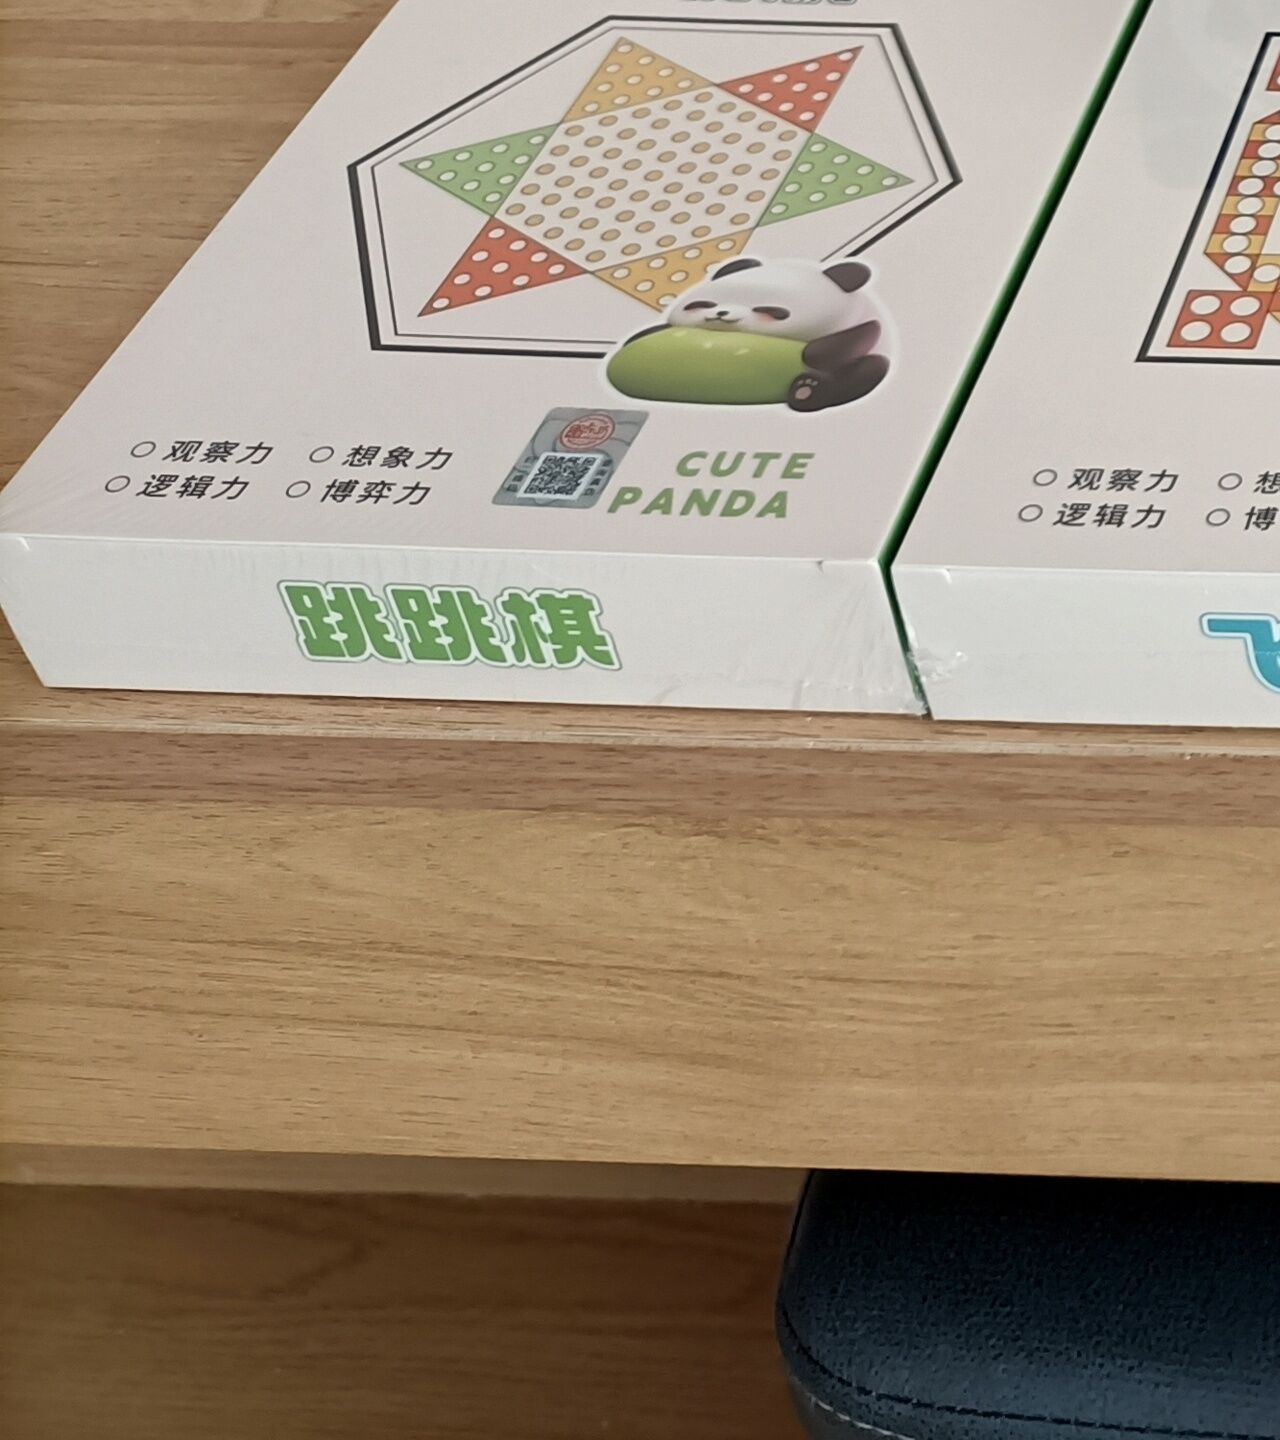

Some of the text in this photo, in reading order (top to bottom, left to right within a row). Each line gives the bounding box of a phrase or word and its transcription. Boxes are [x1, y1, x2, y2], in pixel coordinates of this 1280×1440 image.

[160, 440, 454, 471] 观察力 想象力
[675, 451, 815, 479] CUTE
[135, 474, 431, 507] 逻辑力 博弈力
[1068, 467, 1180, 493] 观察力
[607, 486, 792, 518] PANDA
[1050, 503, 1169, 530] 逻辑力
[278, 579, 622, 670] 跳跳棋
